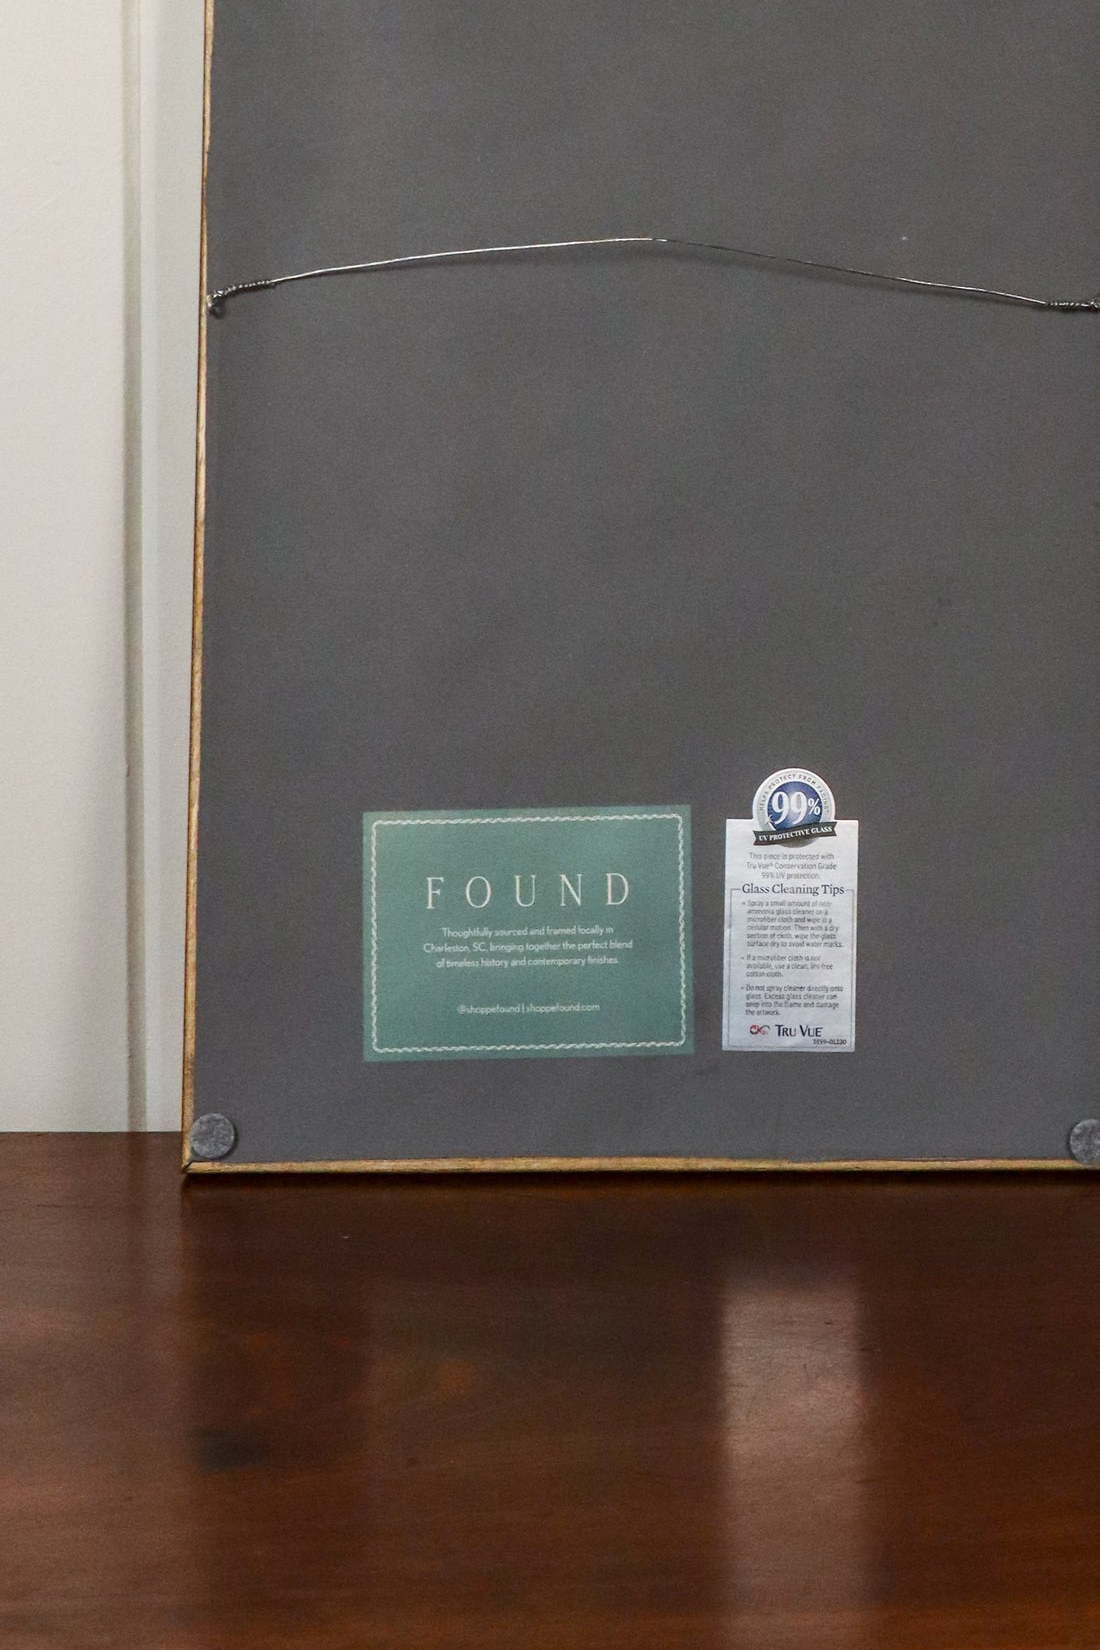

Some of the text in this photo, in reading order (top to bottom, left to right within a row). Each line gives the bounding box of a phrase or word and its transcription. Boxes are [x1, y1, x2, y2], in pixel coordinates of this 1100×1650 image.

[769, 774, 796, 790] PROTECT
[799, 774, 816, 784] FROM
[772, 791, 820, 825] 99%
[770, 829, 810, 841] PROTECTIVE
[811, 826, 832, 834] GLASS
[775, 862, 816, 870] Conservation
[426, 873, 629, 909] FOUND
[742, 883, 844, 896] Glass Cleaning Tips
[442, 927, 492, 938] Thoughtfully
[495, 927, 527, 936] sourced
[530, 926, 544, 935] and
[546, 926, 576, 935] framed
[578, 925, 604, 935] locally
[490, 943, 524, 952] bringing
[526, 942, 560, 952] together
[562, 941, 575, 950] the
[578, 941, 607, 950] perfect
[610, 940, 632, 949] blend
[436, 959, 446, 968] of
[447, 959, 479, 967] timeless
[482, 958, 508, 968] history
[511, 958, 526, 966] and
[528, 957, 586, 967] contemporary
[458, 1003, 599, 1014] @shoppefound shoppefound.com
[775, 1025, 823, 1037] TRU VUE
